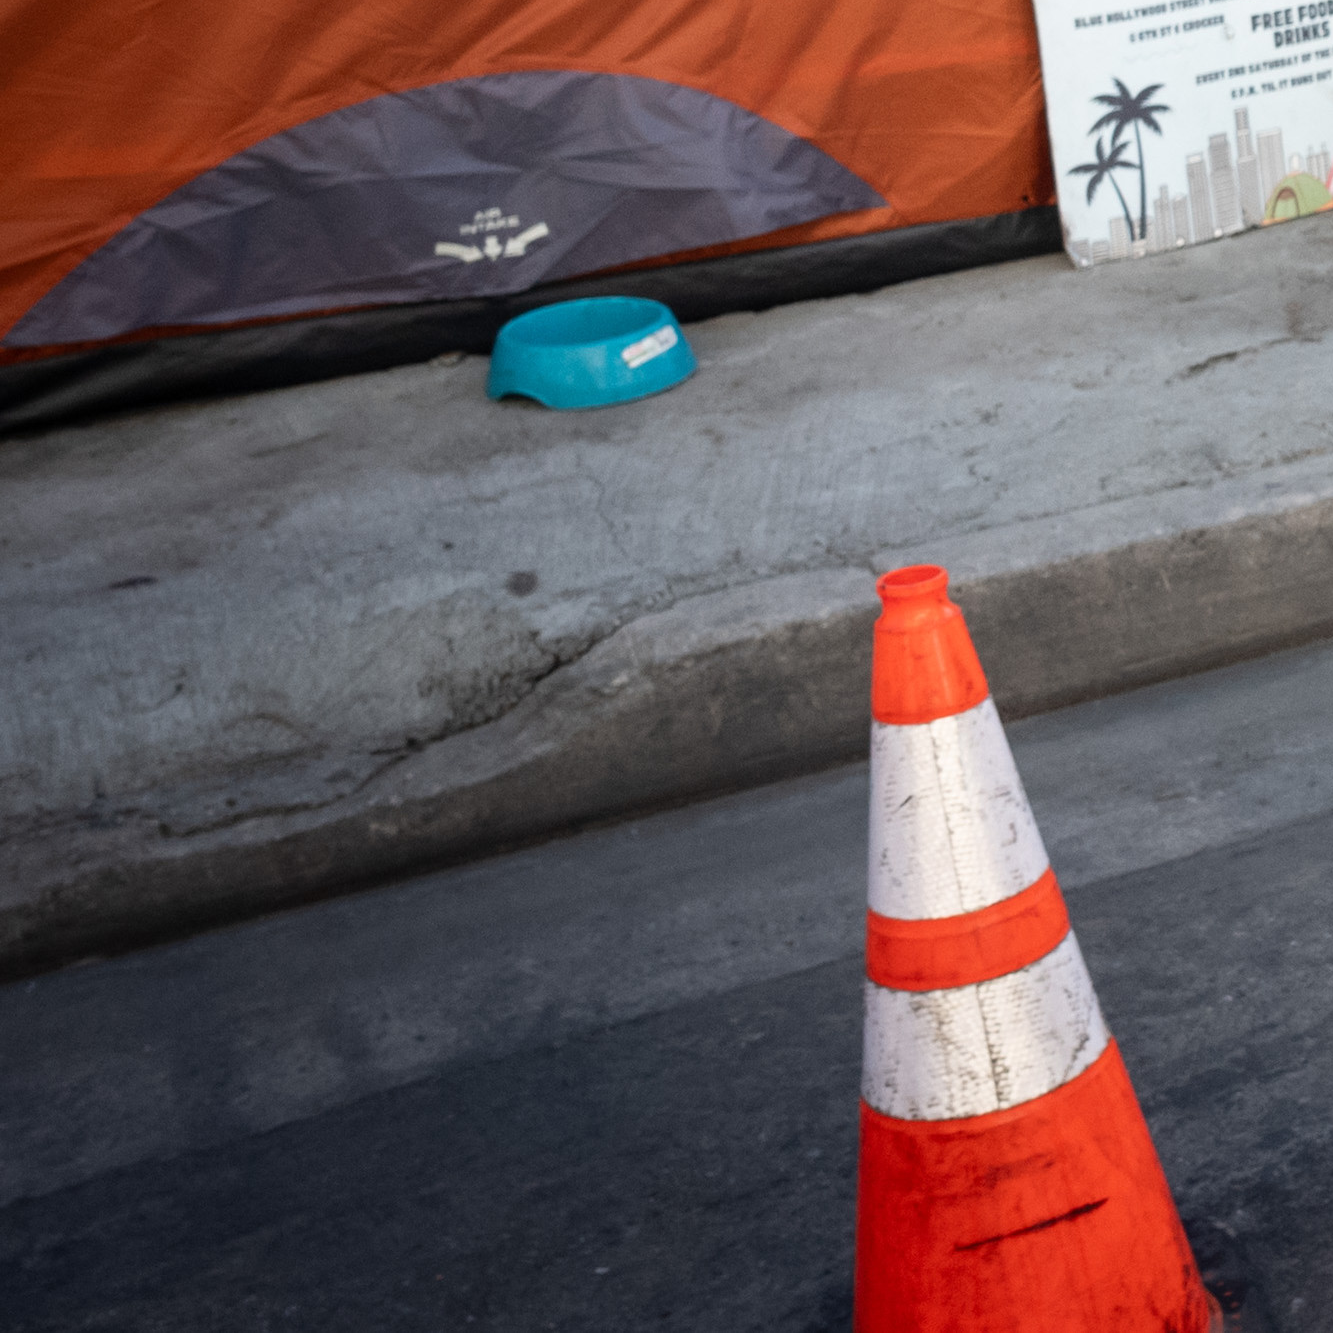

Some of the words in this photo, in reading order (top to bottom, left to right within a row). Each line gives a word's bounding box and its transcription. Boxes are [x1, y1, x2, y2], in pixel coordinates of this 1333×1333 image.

[1106, 3, 1167, 23] HOLLYWOOD
[1250, 8, 1295, 33] FREE
[1273, 20, 1331, 48] DRINKS
[1249, 54, 1299, 73] SATURDAY
